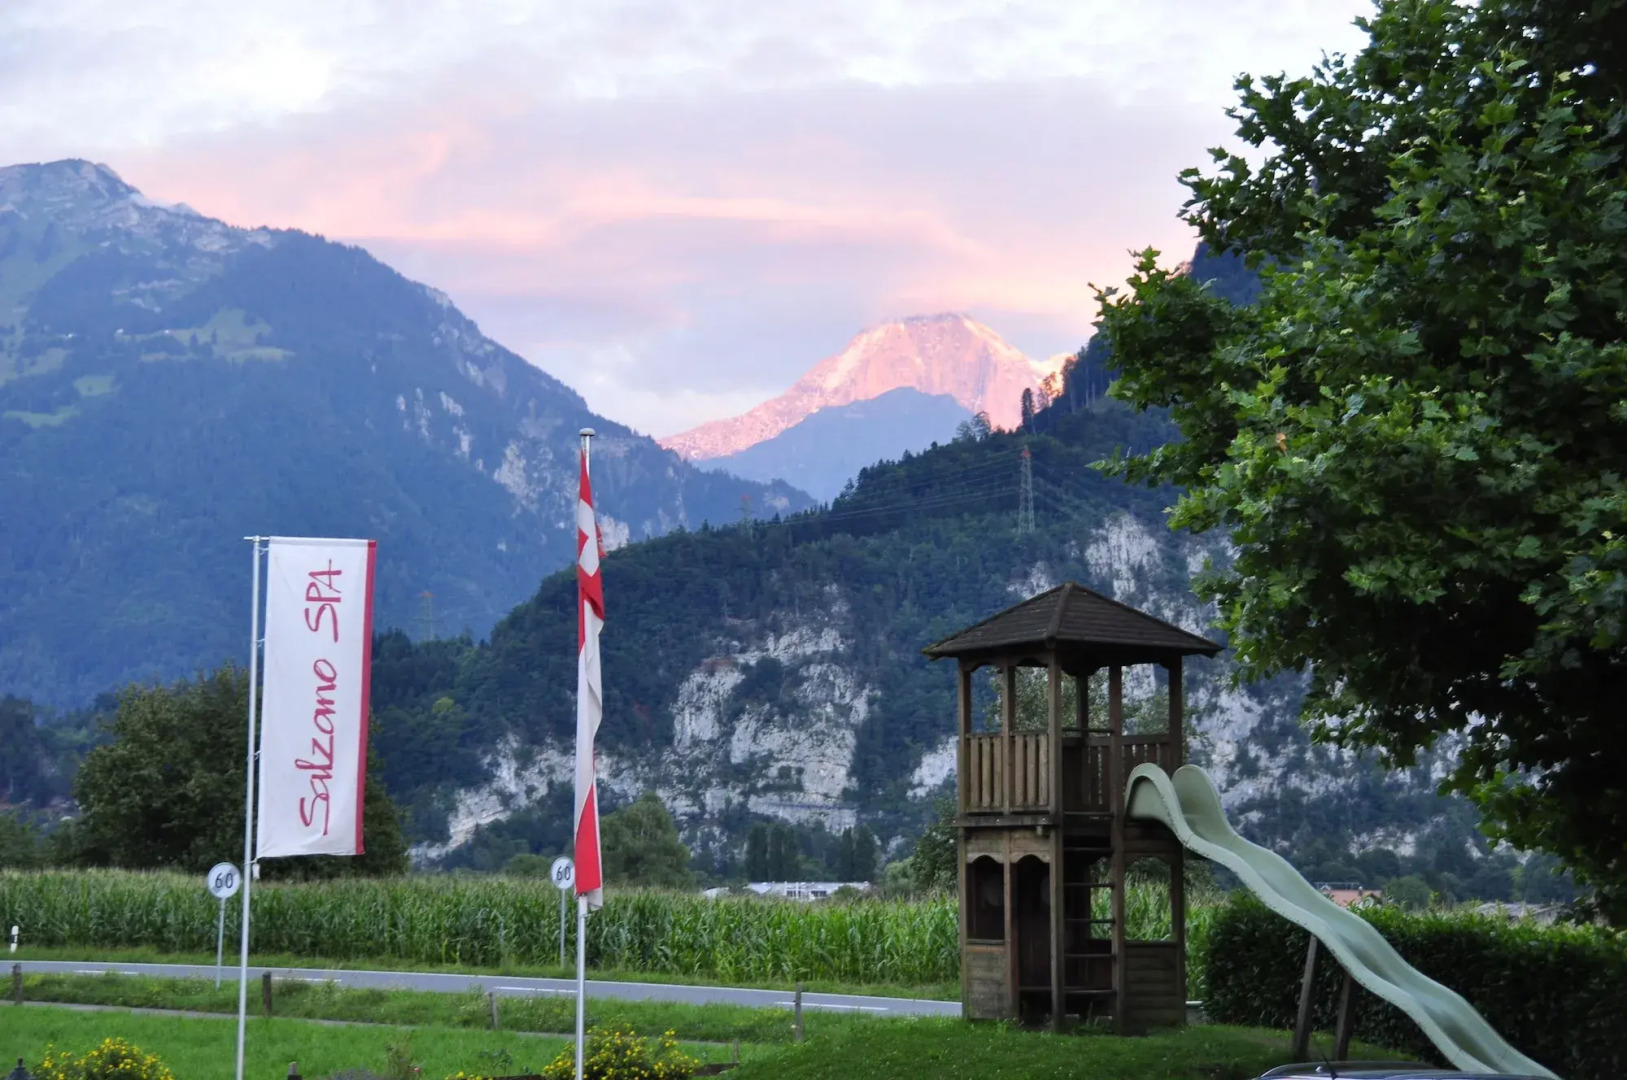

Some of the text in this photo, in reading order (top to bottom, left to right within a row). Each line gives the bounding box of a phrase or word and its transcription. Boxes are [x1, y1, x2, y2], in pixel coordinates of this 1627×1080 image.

[294, 558, 343, 836] Salzano SPA
[215, 872, 234, 889] 60
[556, 865, 571, 881] 60
